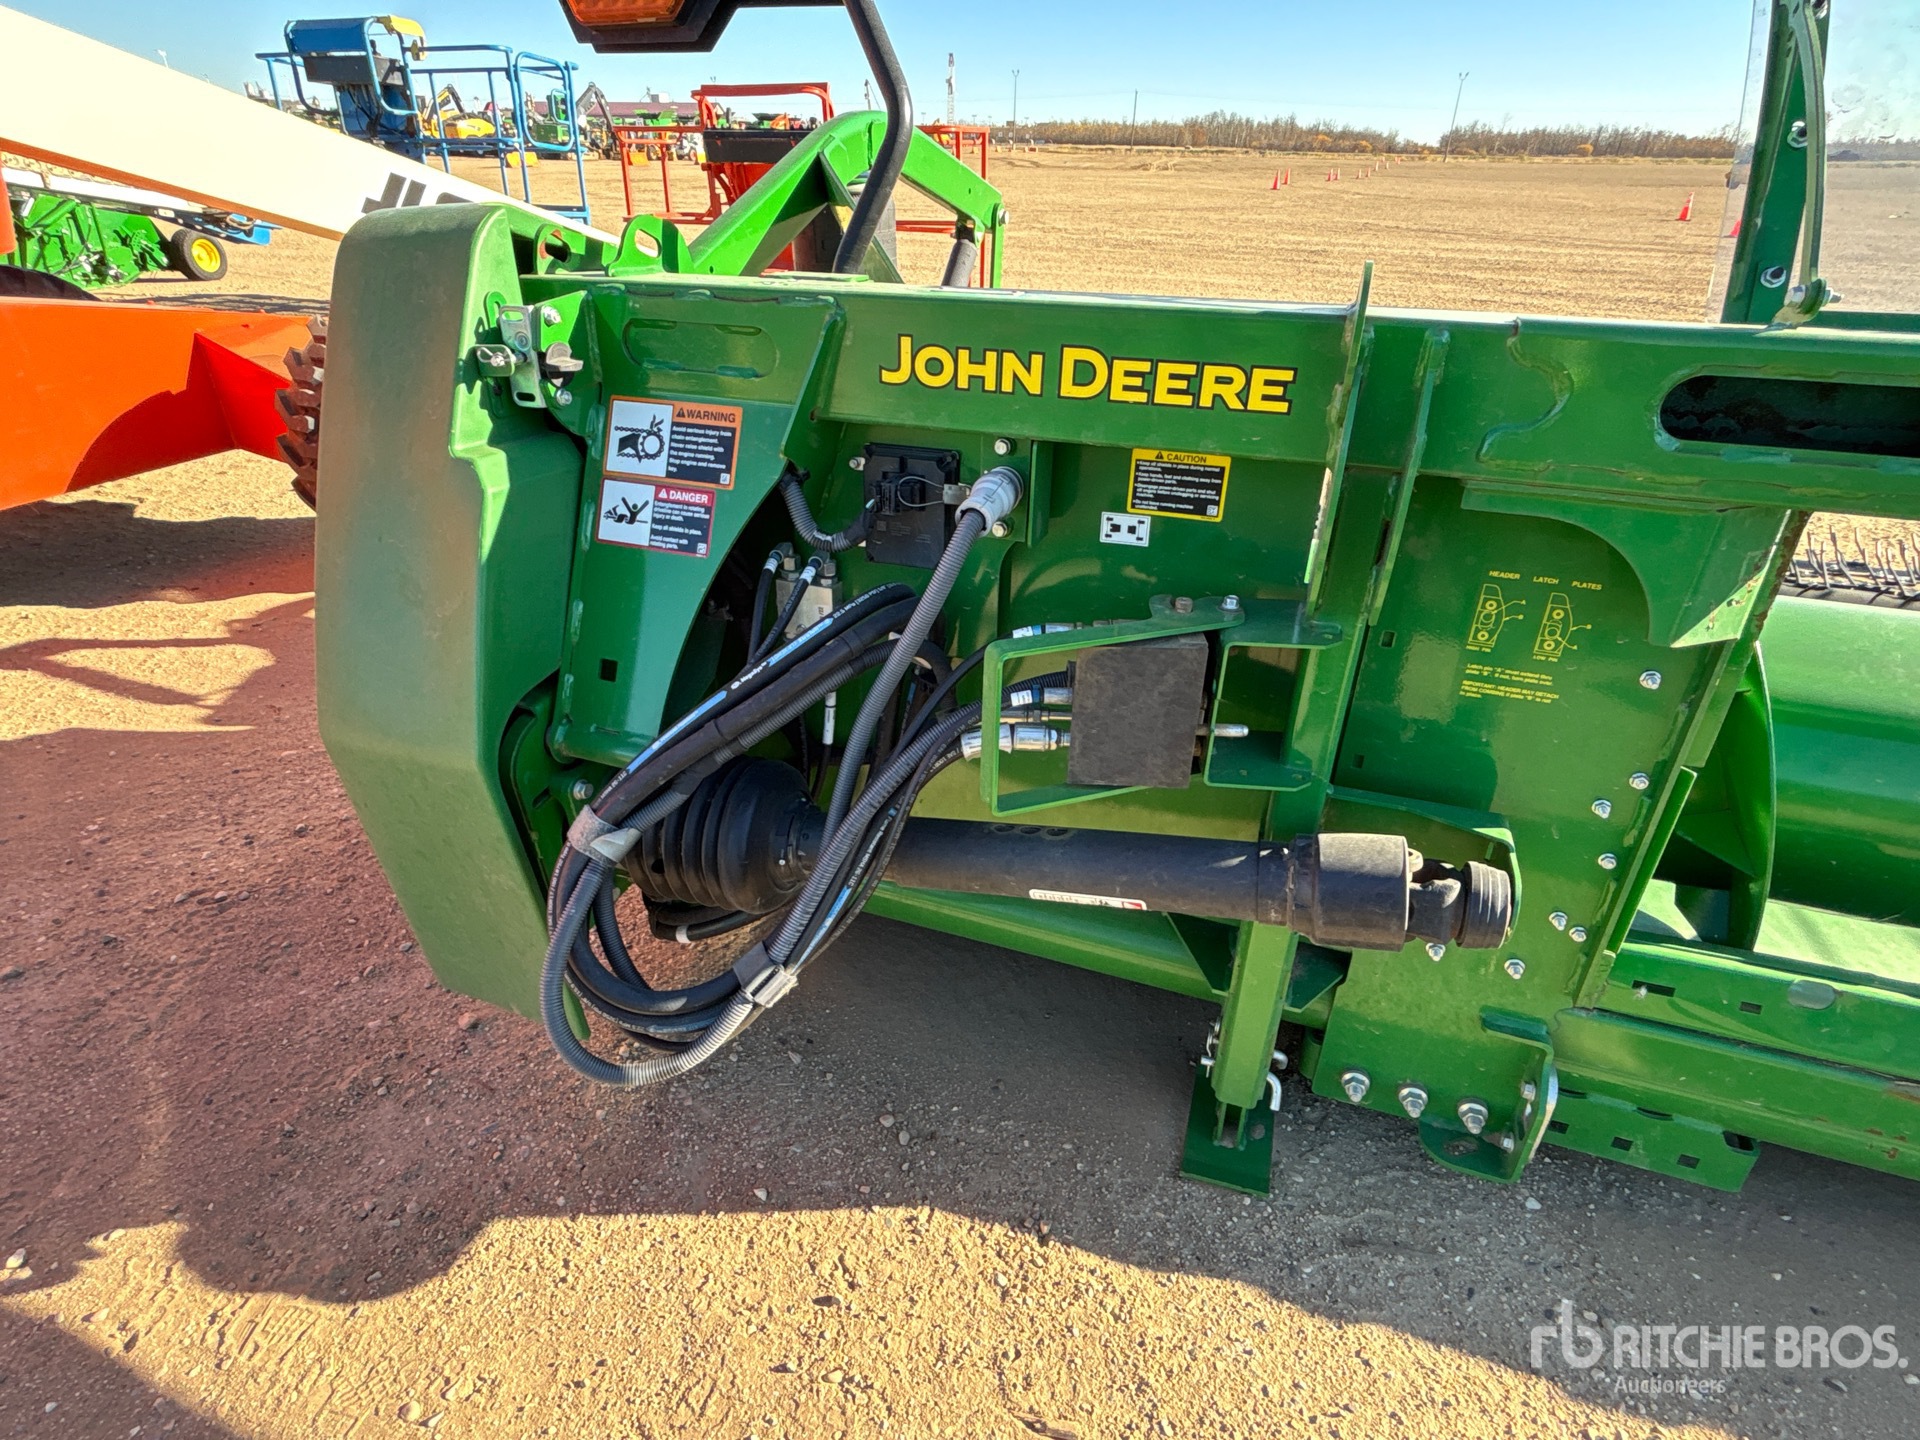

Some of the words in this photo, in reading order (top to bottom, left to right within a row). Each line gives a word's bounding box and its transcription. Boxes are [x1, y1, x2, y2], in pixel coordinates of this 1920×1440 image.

[880, 333, 1046, 397] JOHN
[1057, 344, 1298, 415] DEERE
[687, 409, 735, 422] WARNING
[1167, 453, 1206, 463] CAUTION
[669, 491, 708, 504] DANGER
[1489, 570, 1521, 580] HEADER
[1533, 576, 1559, 585] LATCH
[1571, 581, 1603, 590] PLATES
